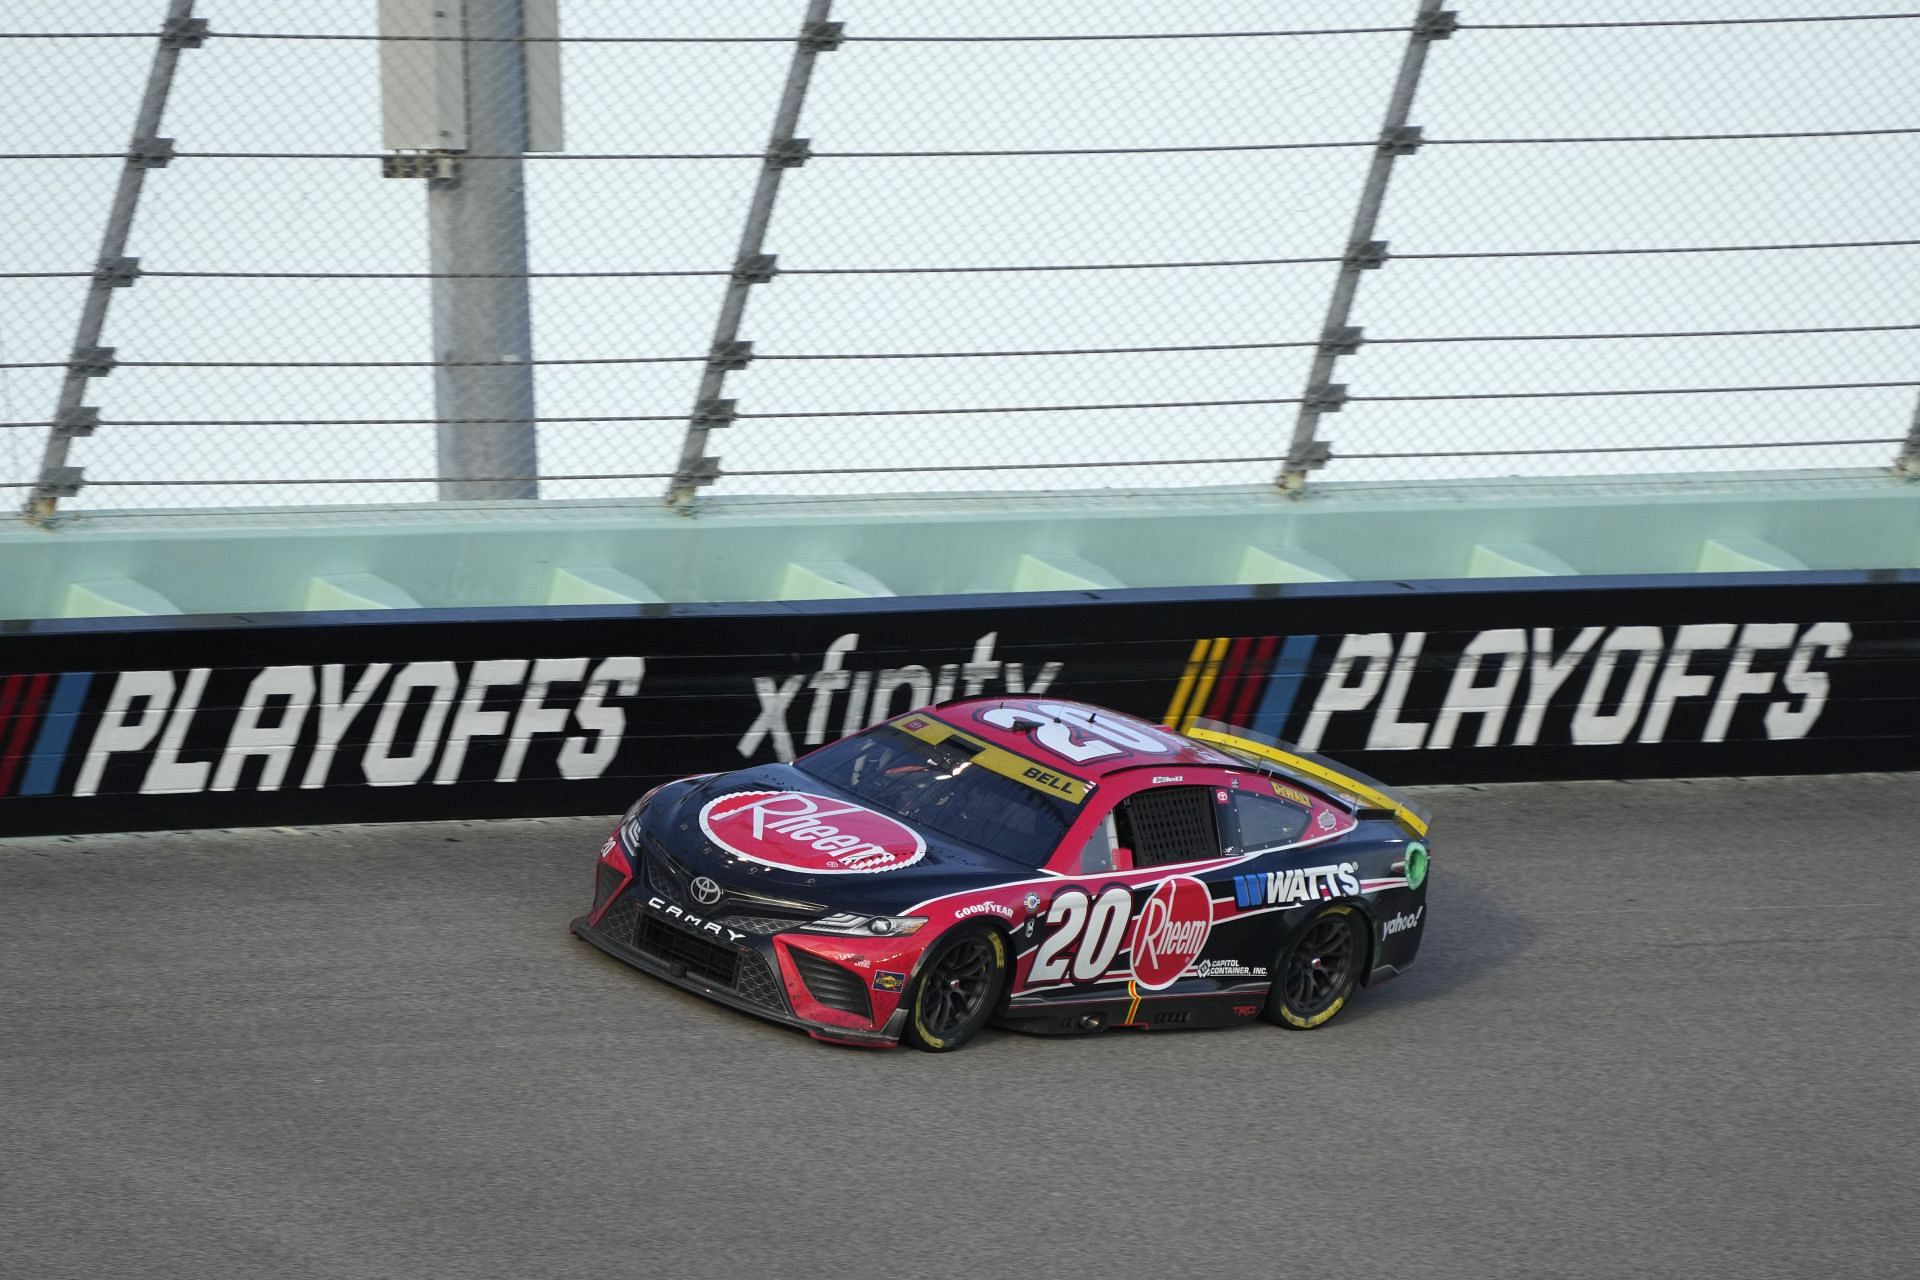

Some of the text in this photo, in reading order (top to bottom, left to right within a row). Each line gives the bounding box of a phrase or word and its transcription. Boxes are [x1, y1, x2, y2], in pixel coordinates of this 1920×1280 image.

[1295, 621, 1853, 753] PLAYOFFS
[72, 656, 646, 797] PLAYOFFS
[1022, 767, 1074, 795] BELL
[710, 793, 896, 871] Rheem
[1266, 862, 1361, 905] WATTS
[648, 897, 747, 942] CAMRY
[955, 901, 1014, 919] GOODYEAR
[1134, 879, 1207, 970] Rheem
[1382, 905, 1424, 942] yahoo!
[1027, 888, 1132, 982] 20
[1211, 959, 1240, 967] CAPITOL
[1253, 967, 1268, 975] INC.
